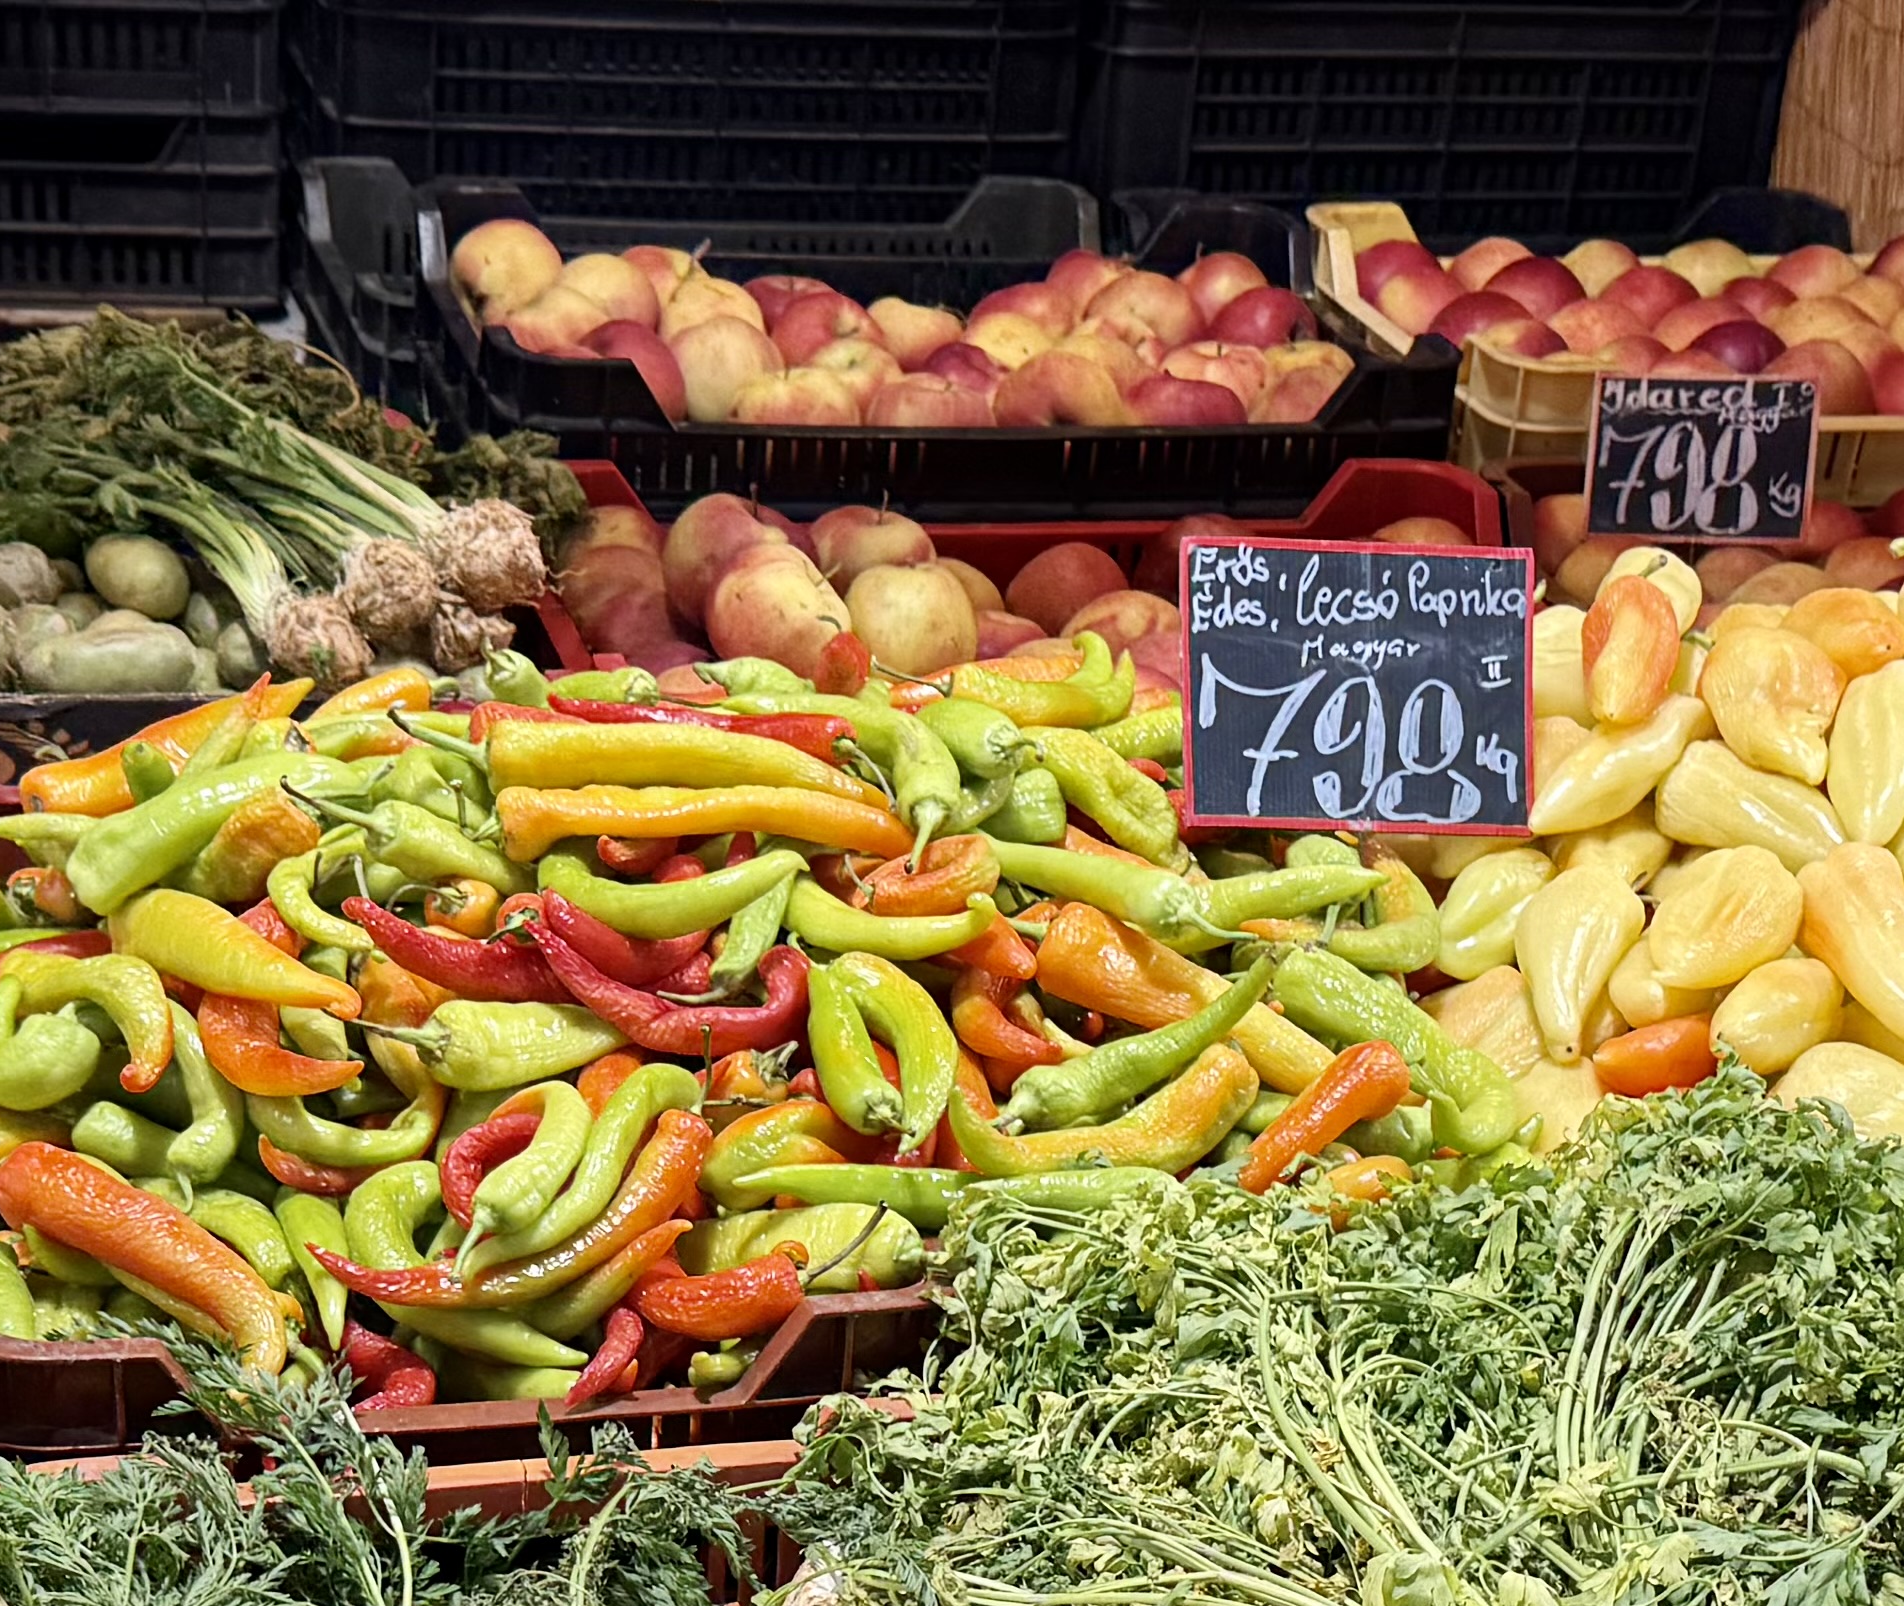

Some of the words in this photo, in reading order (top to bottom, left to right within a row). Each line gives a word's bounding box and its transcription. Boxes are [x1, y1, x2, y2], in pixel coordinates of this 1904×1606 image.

[1598, 421, 1760, 535] 798
[1301, 634, 1421, 671] Magyar
[1198, 652, 1482, 823] 798
